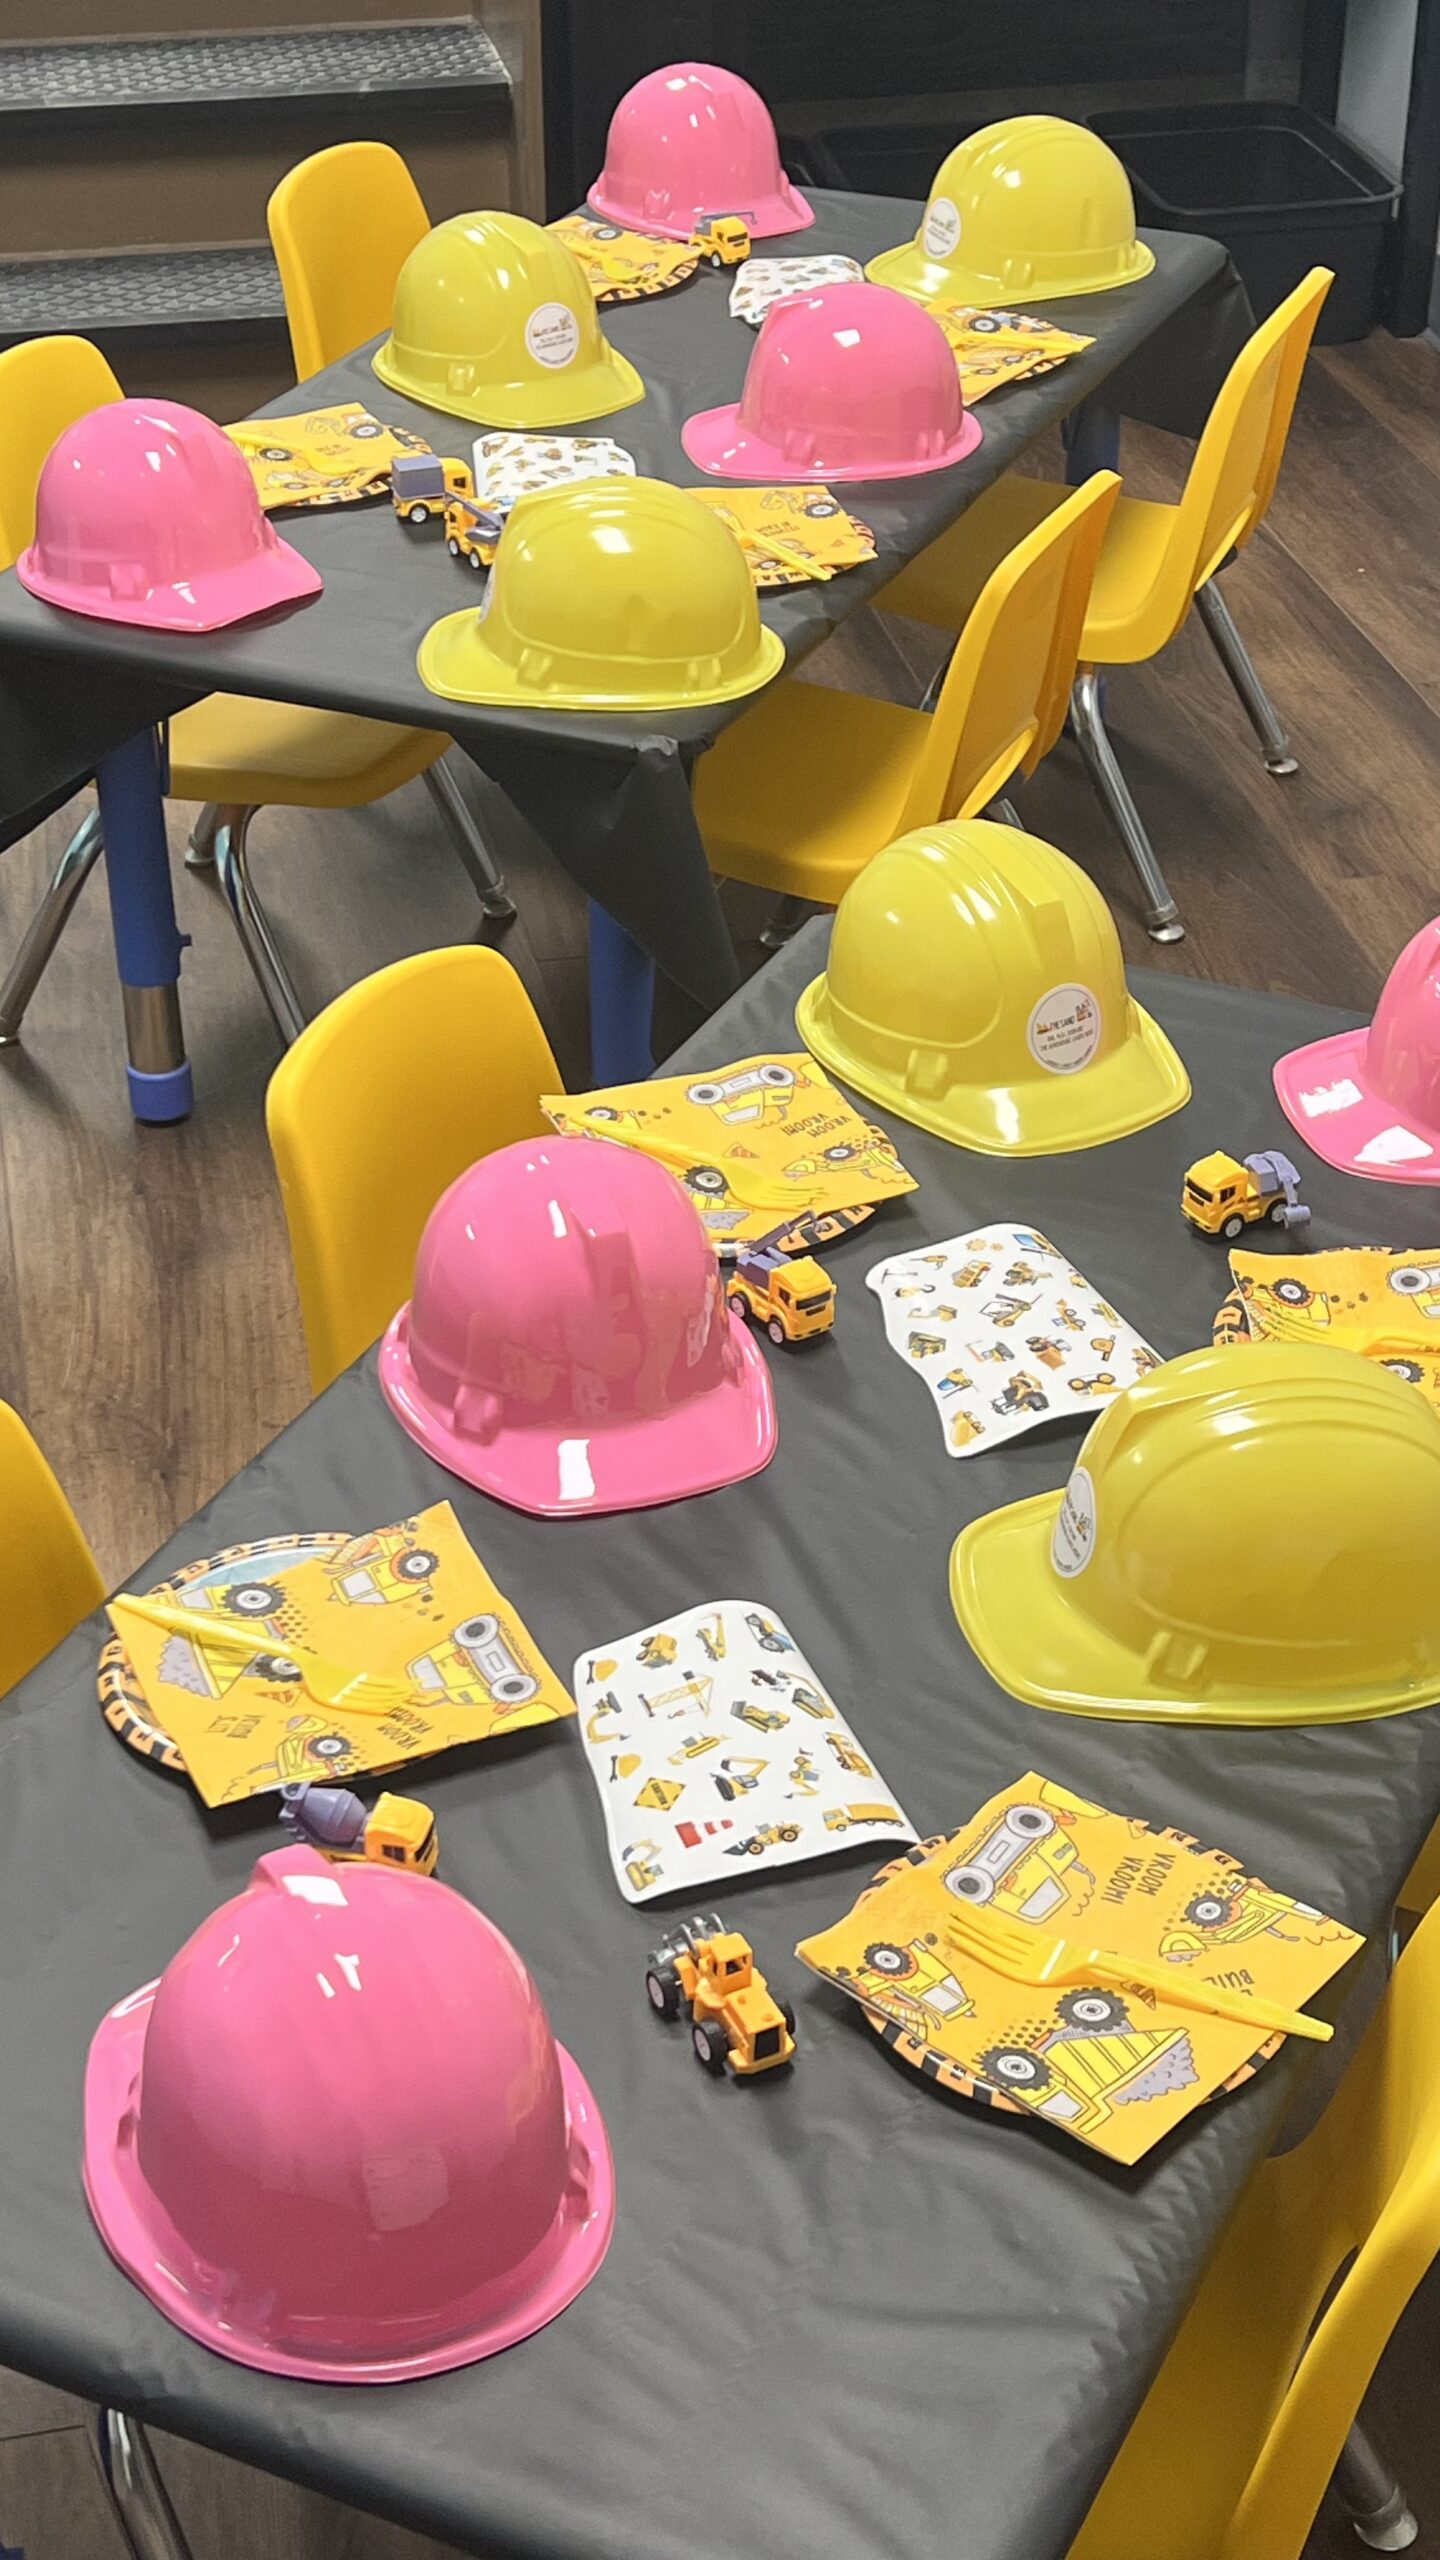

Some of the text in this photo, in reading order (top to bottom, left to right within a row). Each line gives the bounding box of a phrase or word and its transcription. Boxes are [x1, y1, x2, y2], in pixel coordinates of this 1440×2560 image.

[780, 1112, 829, 1136] VROOM!
[807, 1115, 854, 1138] VROOM
[376, 1723, 422, 1750] VROOM
[1100, 1856, 1146, 1905] VROOM!
[1136, 1852, 1176, 1896] VROOM
[1201, 1968, 1255, 1989] BUIL
